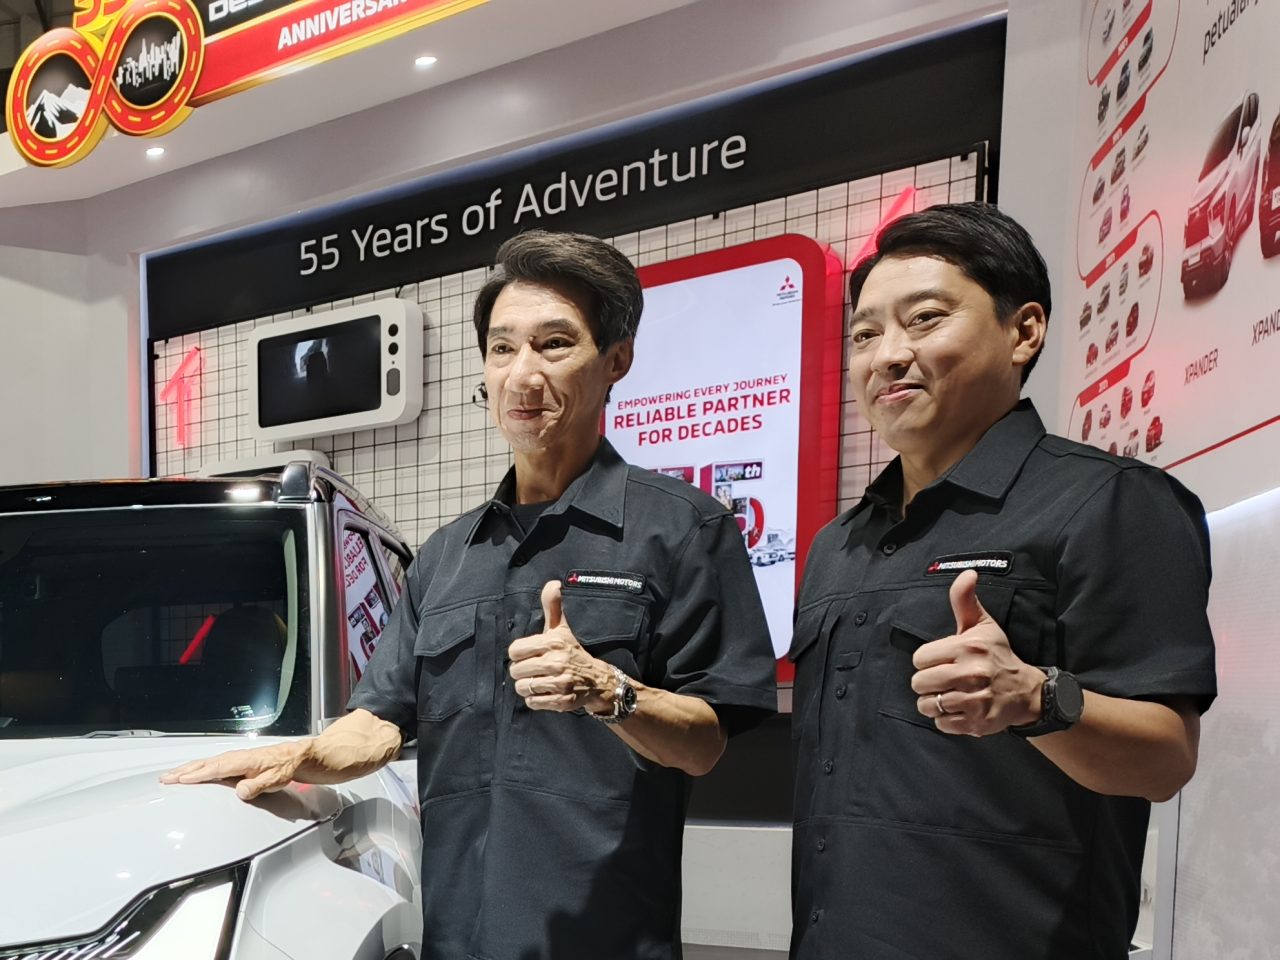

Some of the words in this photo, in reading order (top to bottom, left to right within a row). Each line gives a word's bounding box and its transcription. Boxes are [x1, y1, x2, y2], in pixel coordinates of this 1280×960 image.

[299, 233, 340, 276] 55
[351, 212, 449, 262] Years
[461, 188, 503, 236] of
[513, 134, 747, 224] Adventure
[1184, 348, 1219, 386] XPANDER
[614, 403, 696, 429] RELIABLE
[703, 388, 791, 416] PARTNER
[618, 389, 691, 410] EMPOWERING
[694, 383, 730, 398] EVERY
[733, 373, 788, 392] JOURNEY
[638, 428, 672, 446] FOR
[678, 414, 763, 441] DECADES
[613, 577, 643, 588] MOTORS
